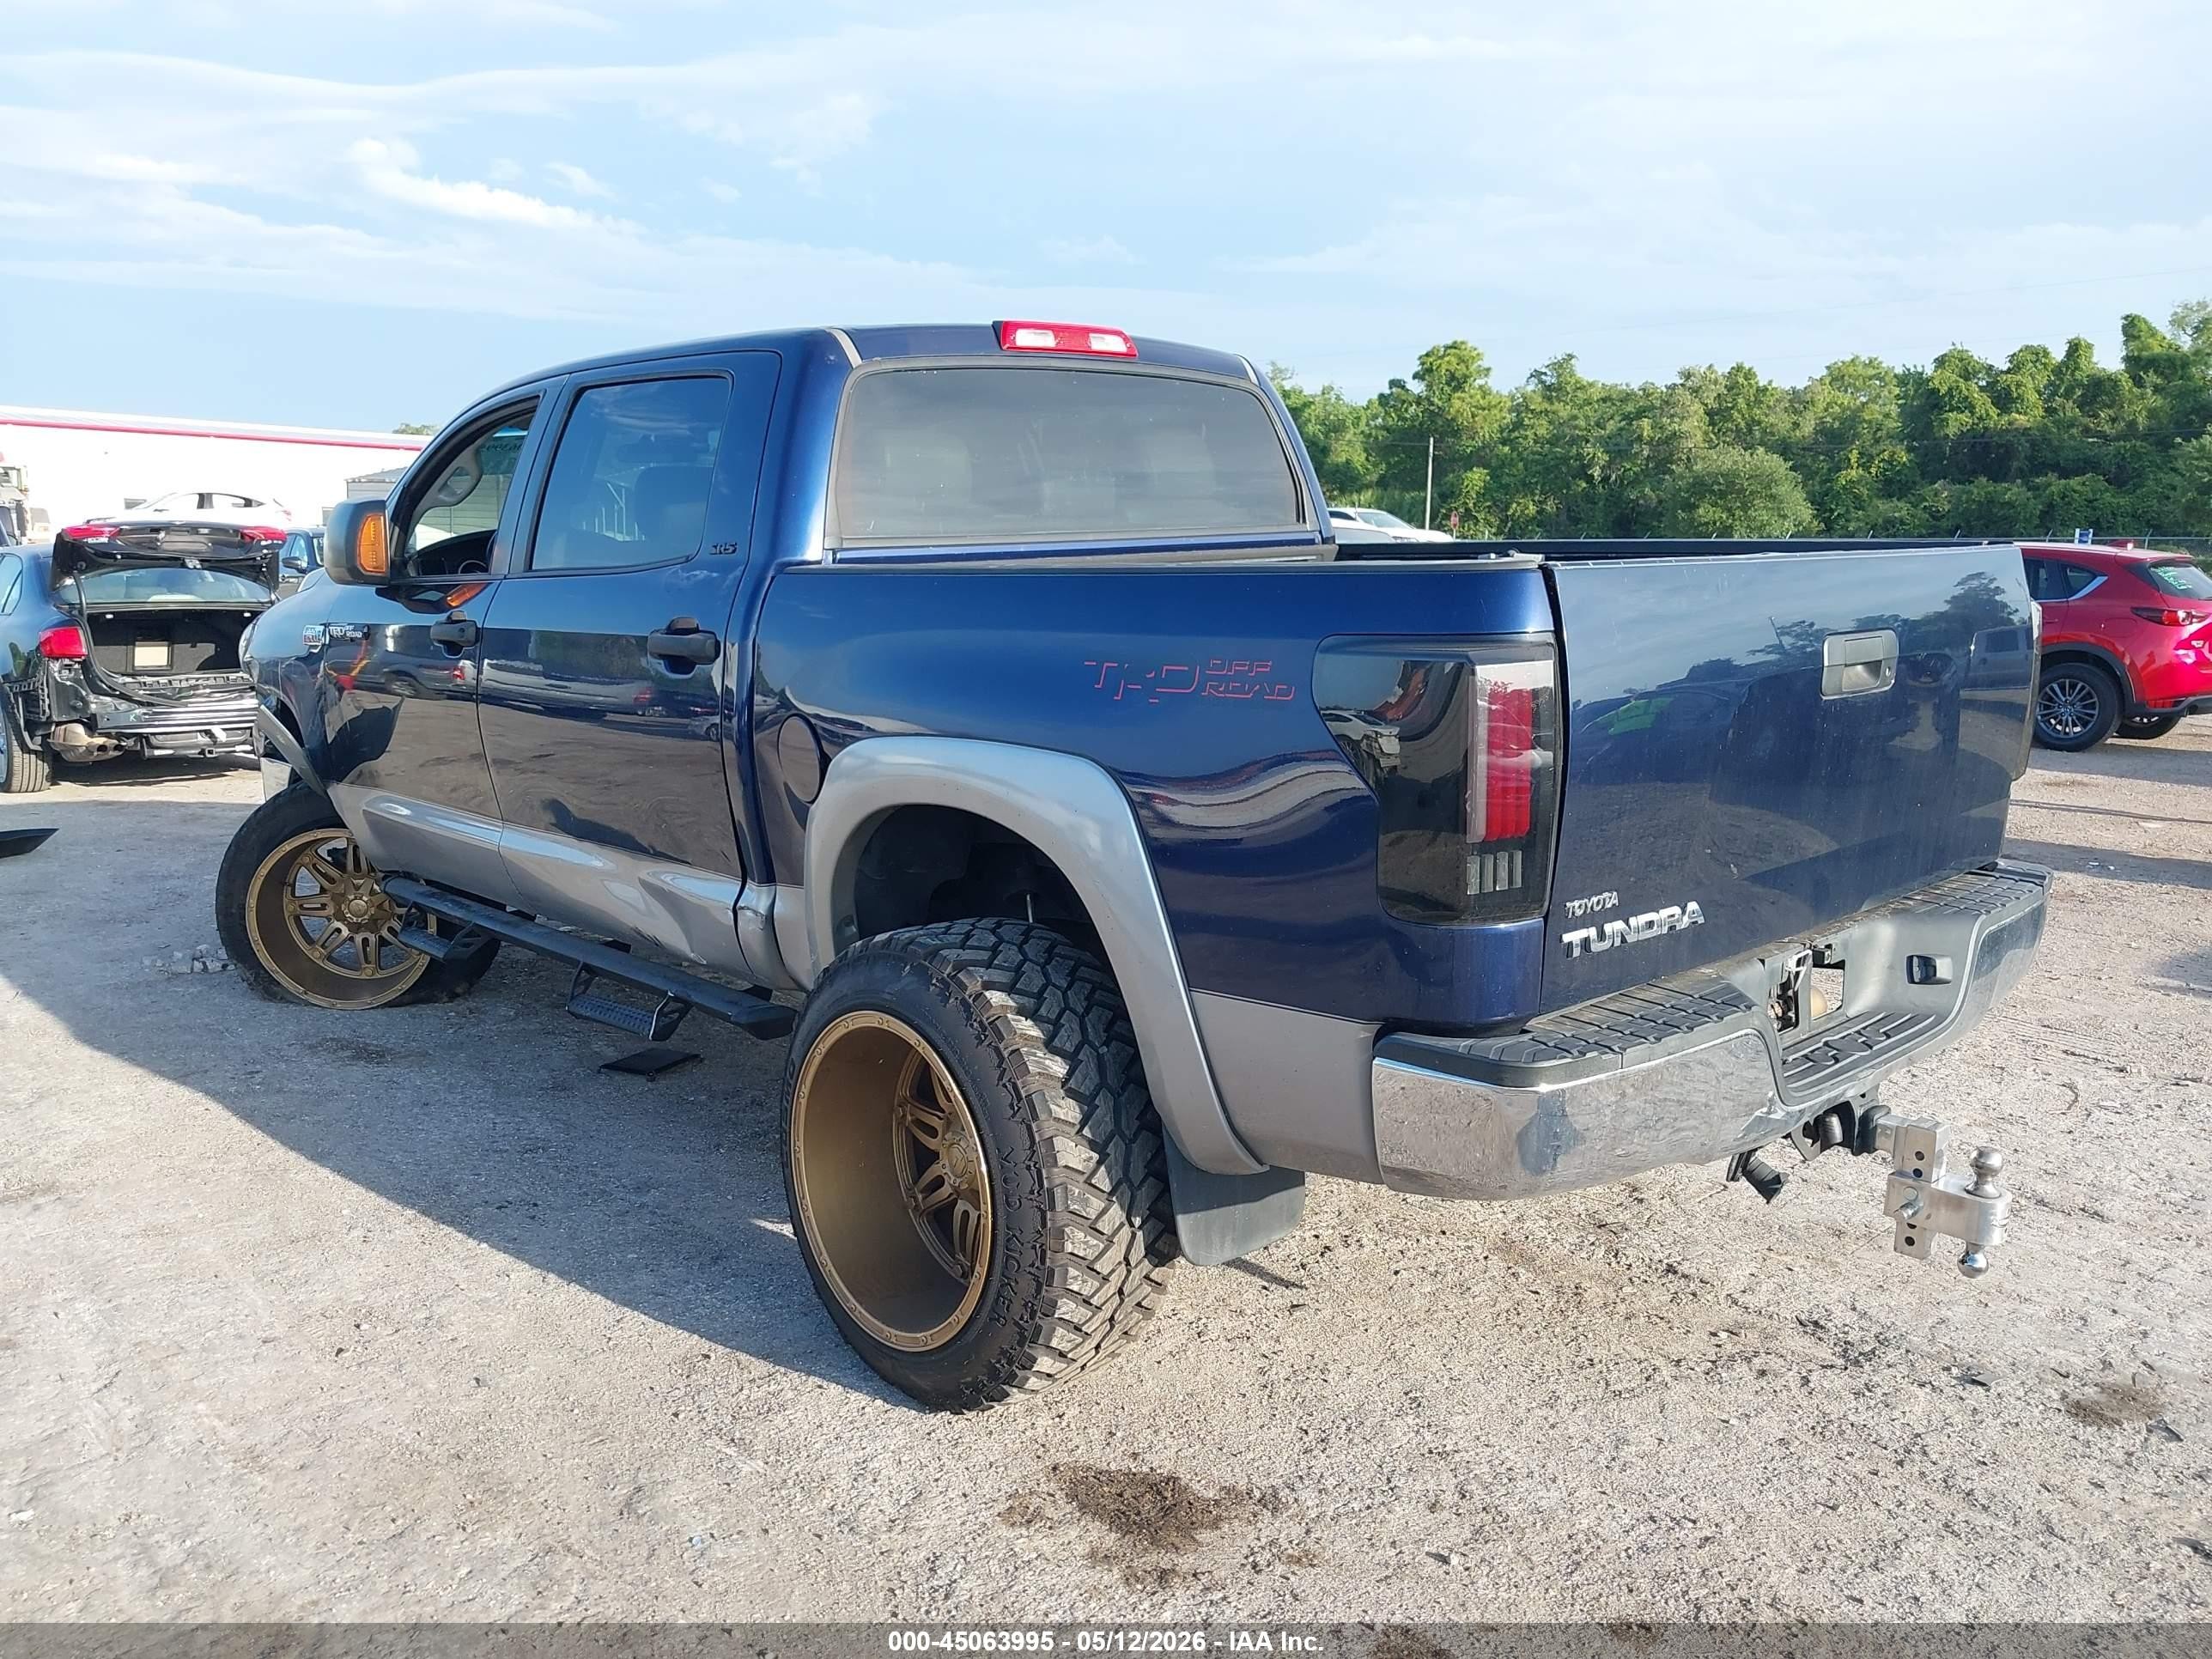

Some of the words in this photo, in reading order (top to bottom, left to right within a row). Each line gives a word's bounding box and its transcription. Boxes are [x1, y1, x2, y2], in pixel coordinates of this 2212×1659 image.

[1205, 659, 1273, 677] OFF
[1201, 681, 1296, 702] ROAD
[1565, 890, 1620, 919] TOYOTA
[1559, 901, 1705, 959] TUNDRA
